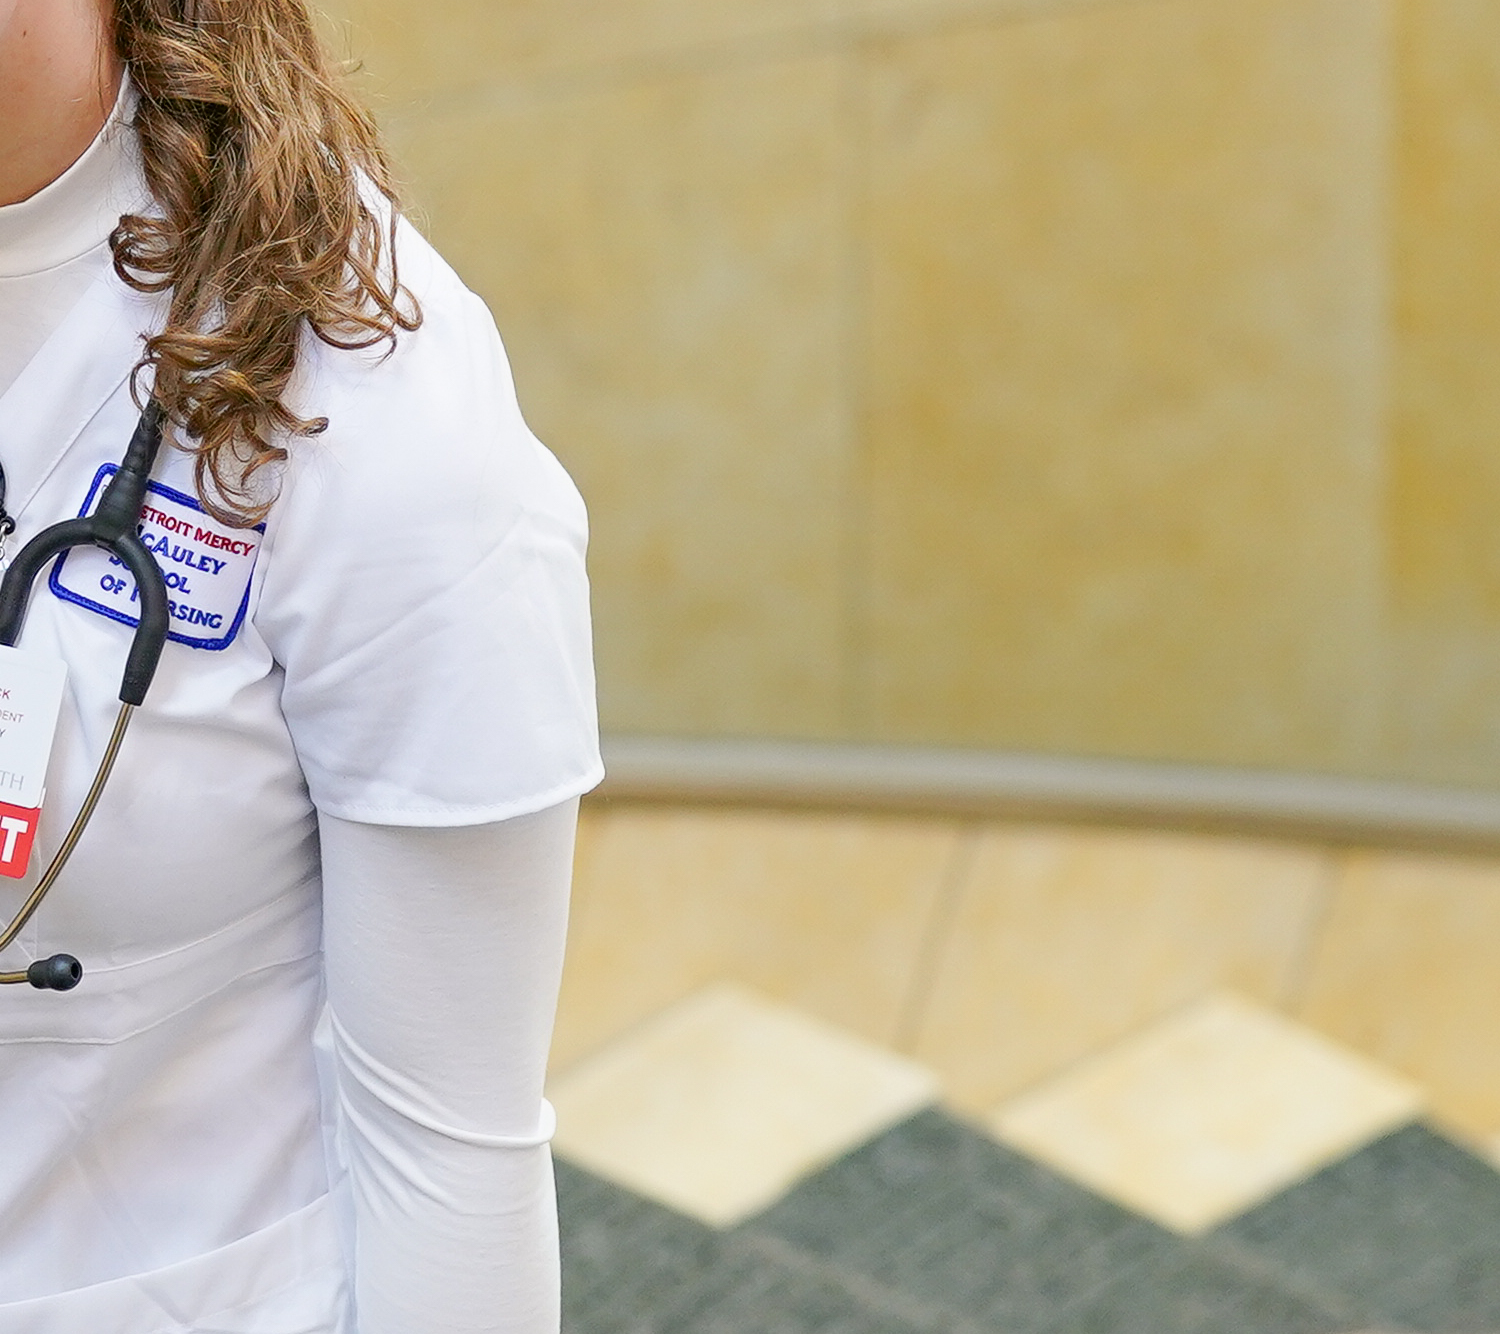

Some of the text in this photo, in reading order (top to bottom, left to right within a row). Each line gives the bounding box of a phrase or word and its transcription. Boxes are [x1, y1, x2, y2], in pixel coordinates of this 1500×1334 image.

[140, 505, 256, 557] ETROIT MERCY
[100, 574, 127, 595] OF
